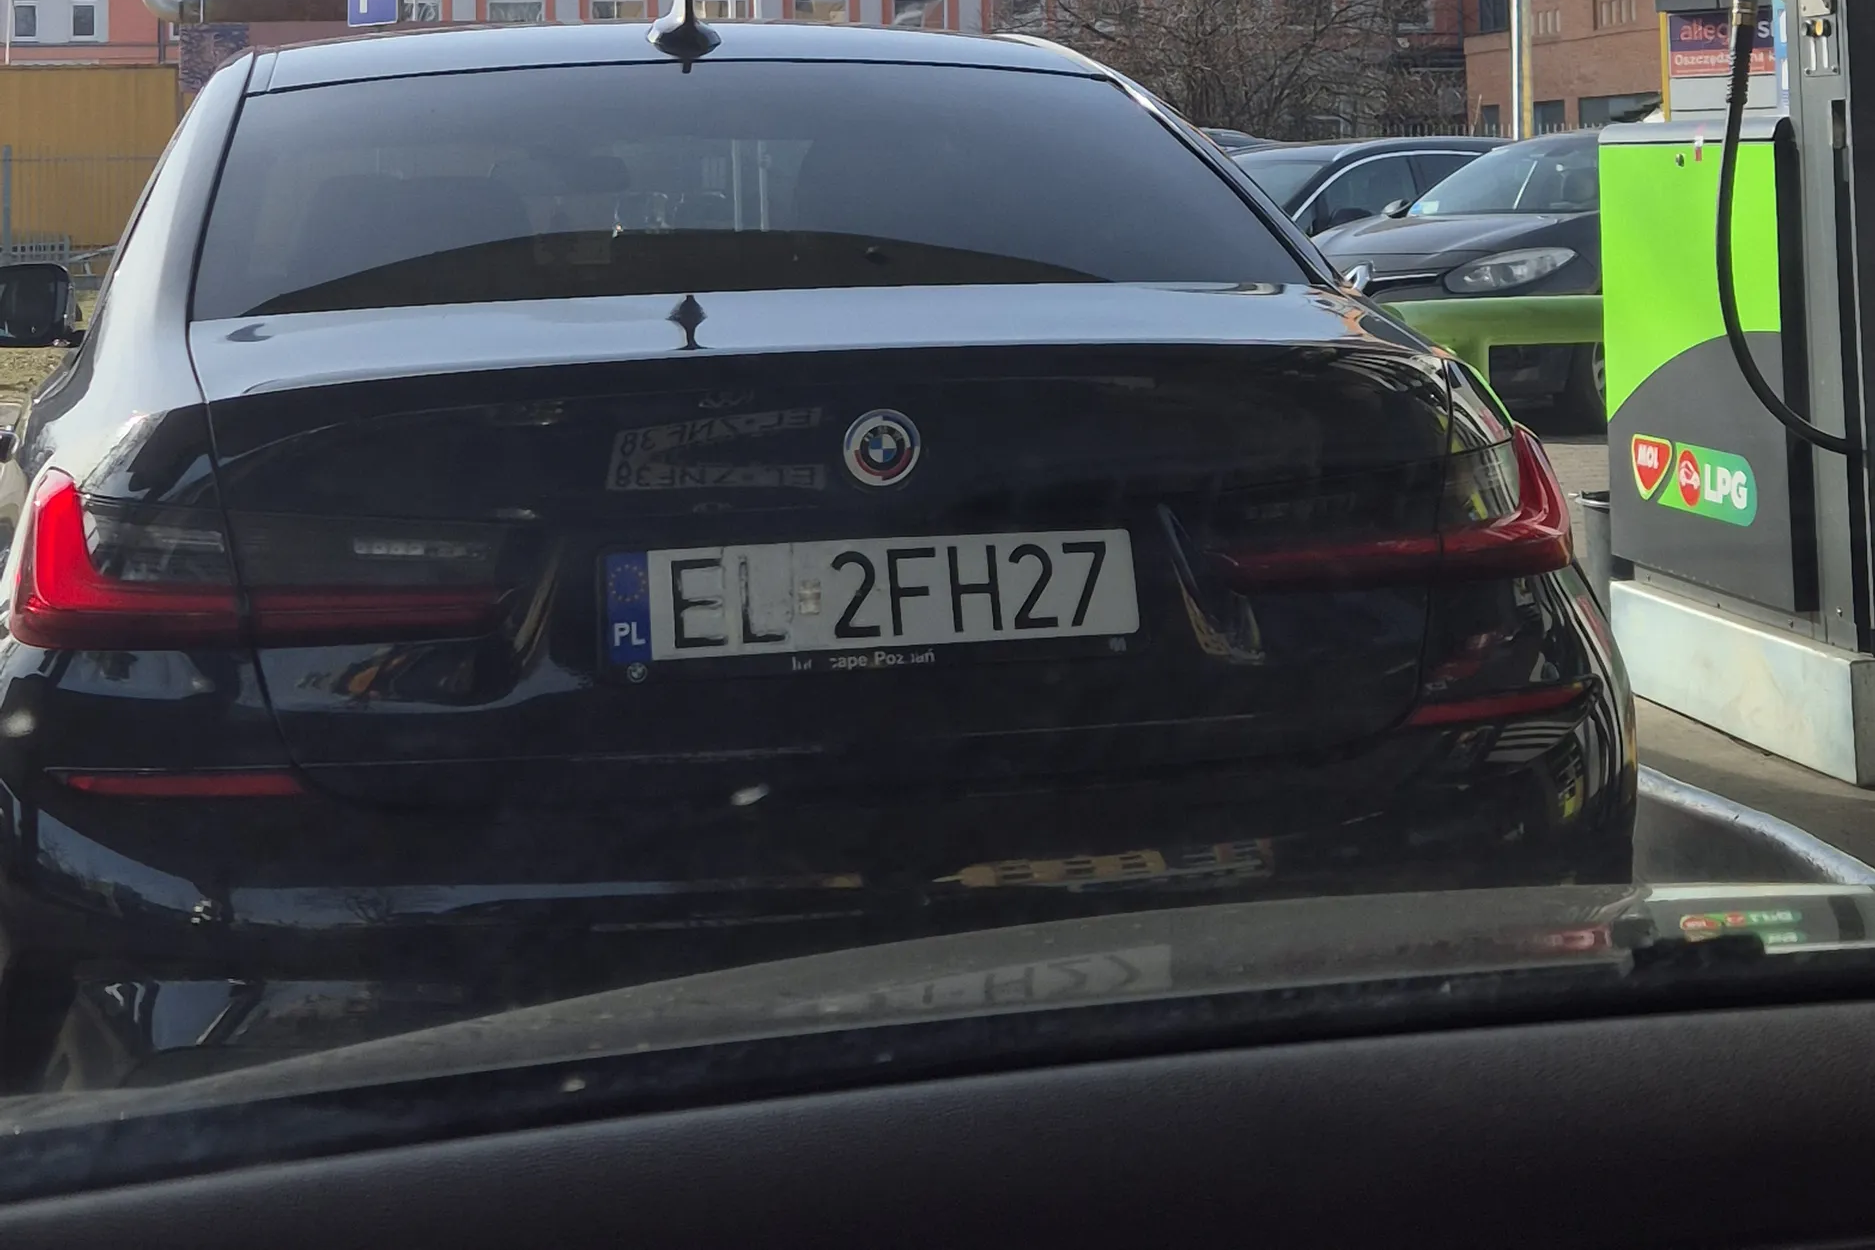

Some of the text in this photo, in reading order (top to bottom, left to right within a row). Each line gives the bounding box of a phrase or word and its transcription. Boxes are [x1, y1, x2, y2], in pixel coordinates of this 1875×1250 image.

[1638, 444, 1657, 468] MOL
[1703, 463, 1748, 510] LPG
[830, 540, 1107, 639] 2FH27
[613, 621, 646, 648] PL
